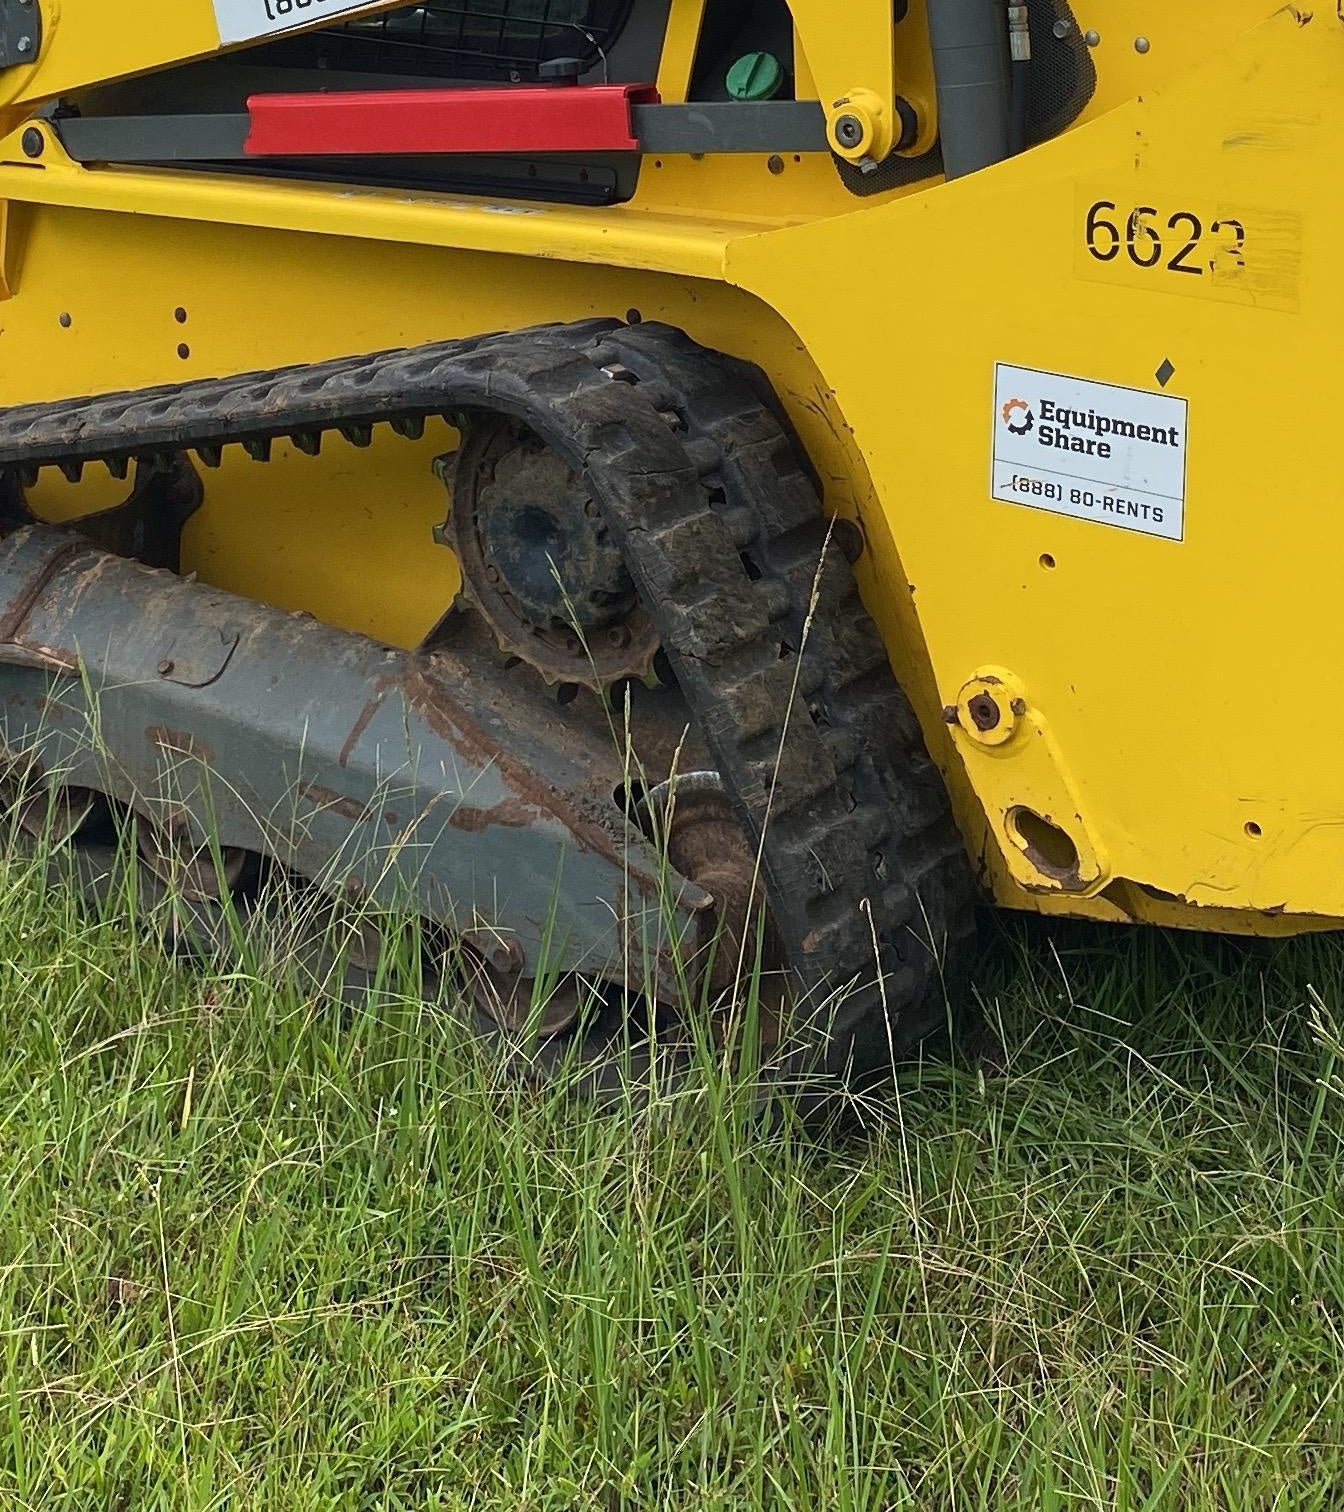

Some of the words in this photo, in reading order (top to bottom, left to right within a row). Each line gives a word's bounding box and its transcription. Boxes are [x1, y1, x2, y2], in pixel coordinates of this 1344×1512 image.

[1038, 425, 1112, 459] Share
[1039, 399, 1179, 448] Equipment
[1012, 475, 1062, 501] (888)
[1070, 489, 1164, 523] 80-RENTS
